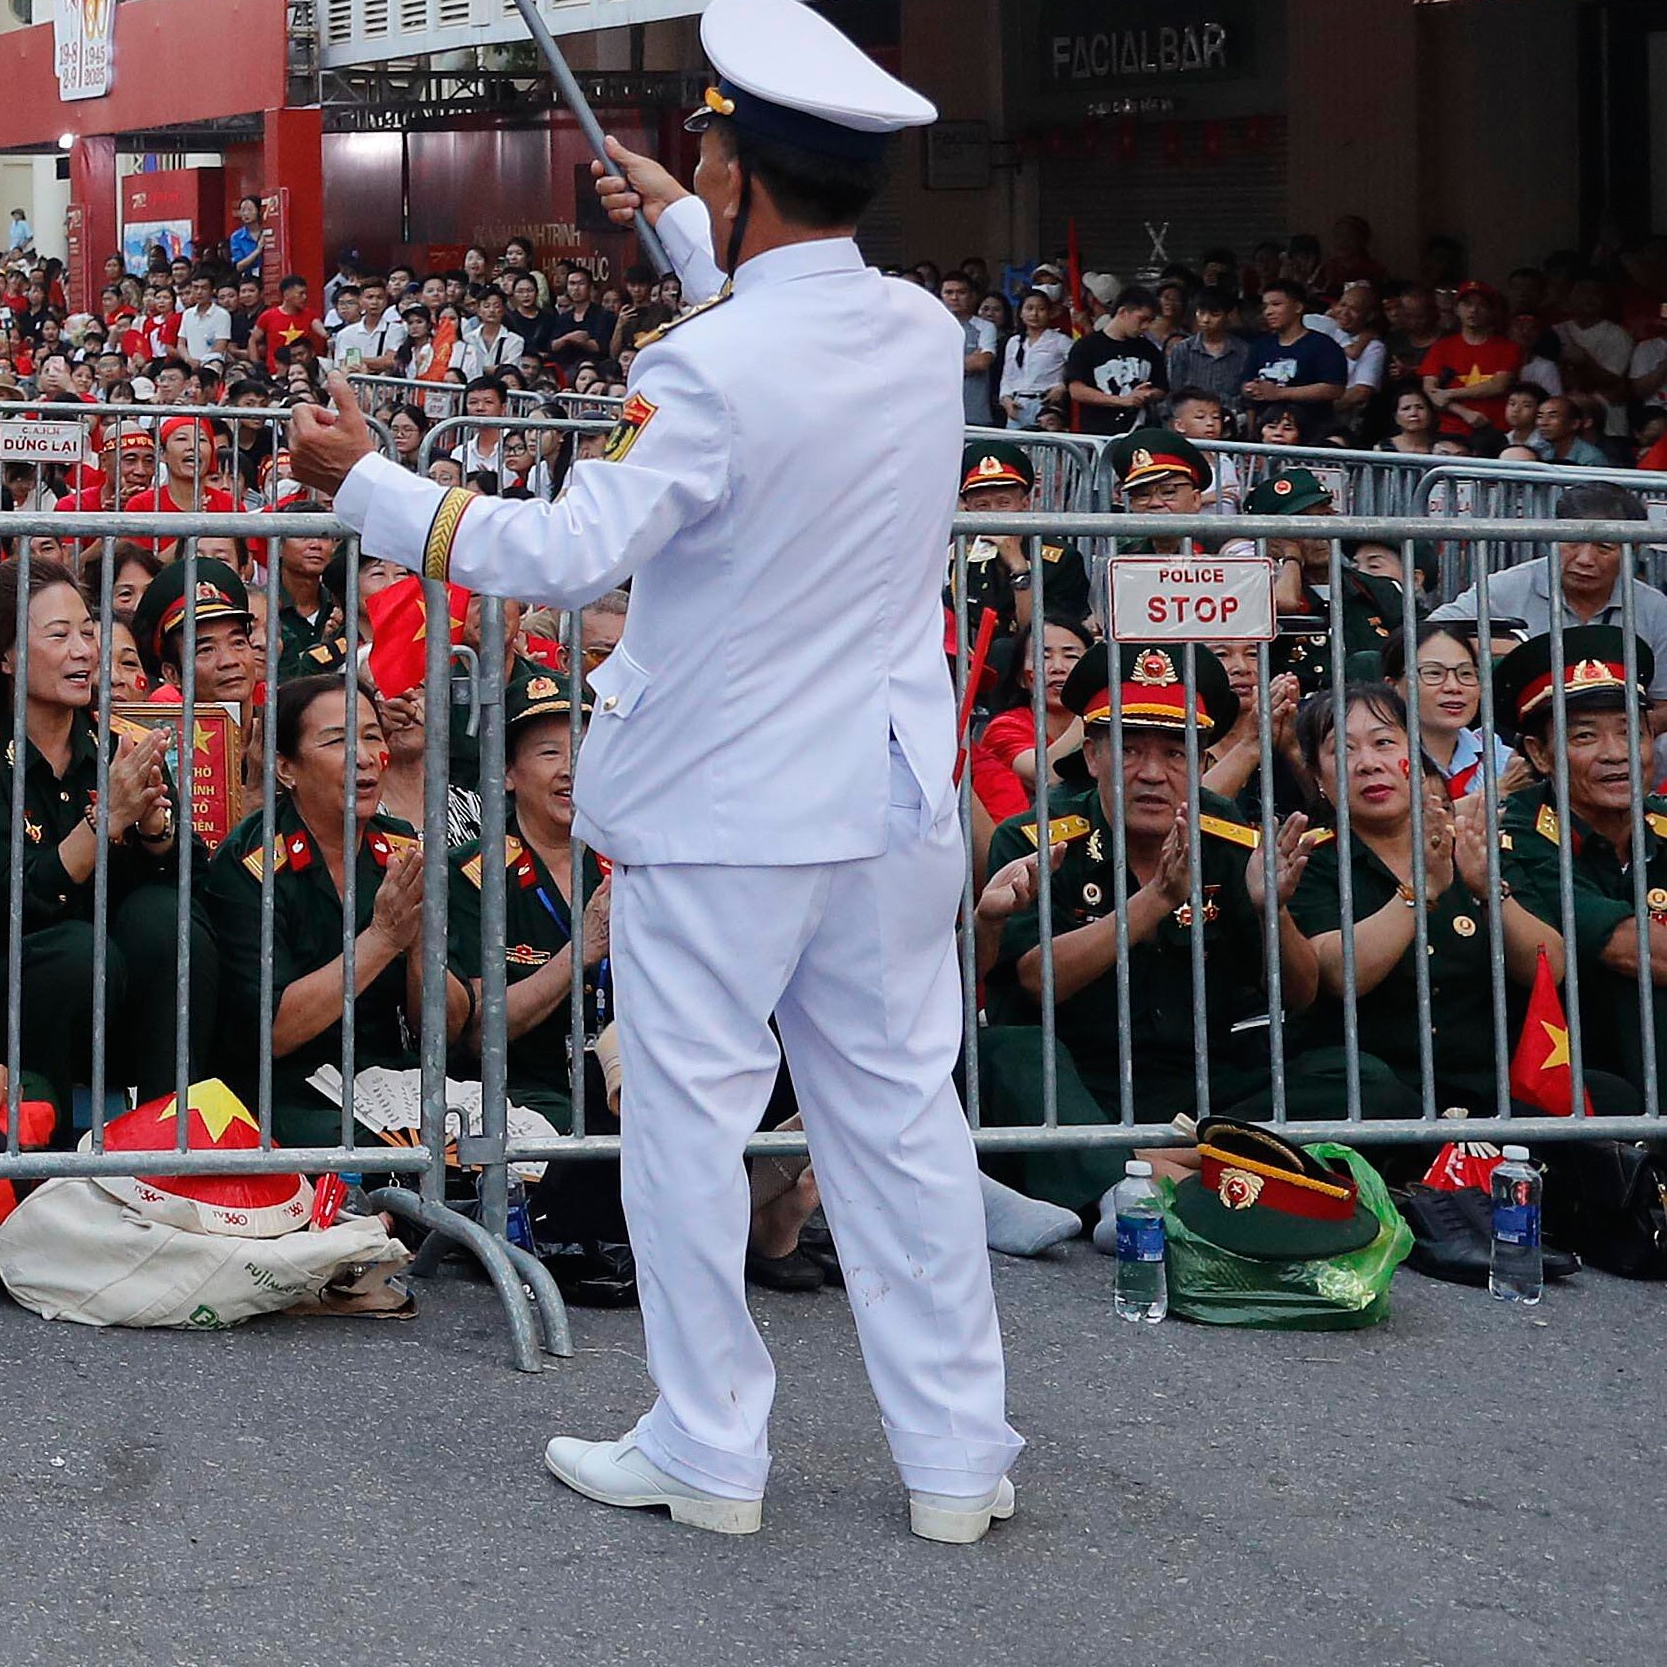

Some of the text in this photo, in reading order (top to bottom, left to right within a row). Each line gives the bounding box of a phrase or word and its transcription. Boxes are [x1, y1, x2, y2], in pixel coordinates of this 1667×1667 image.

[84, 46, 106, 66] 1945
[84, 67, 106, 86] 2025
[4, 436, 77, 454] DỪNG LẠI
[1159, 568, 1224, 583] POLICE
[1147, 595, 1239, 623] STOP
[212, 1210, 249, 1226] TV360
